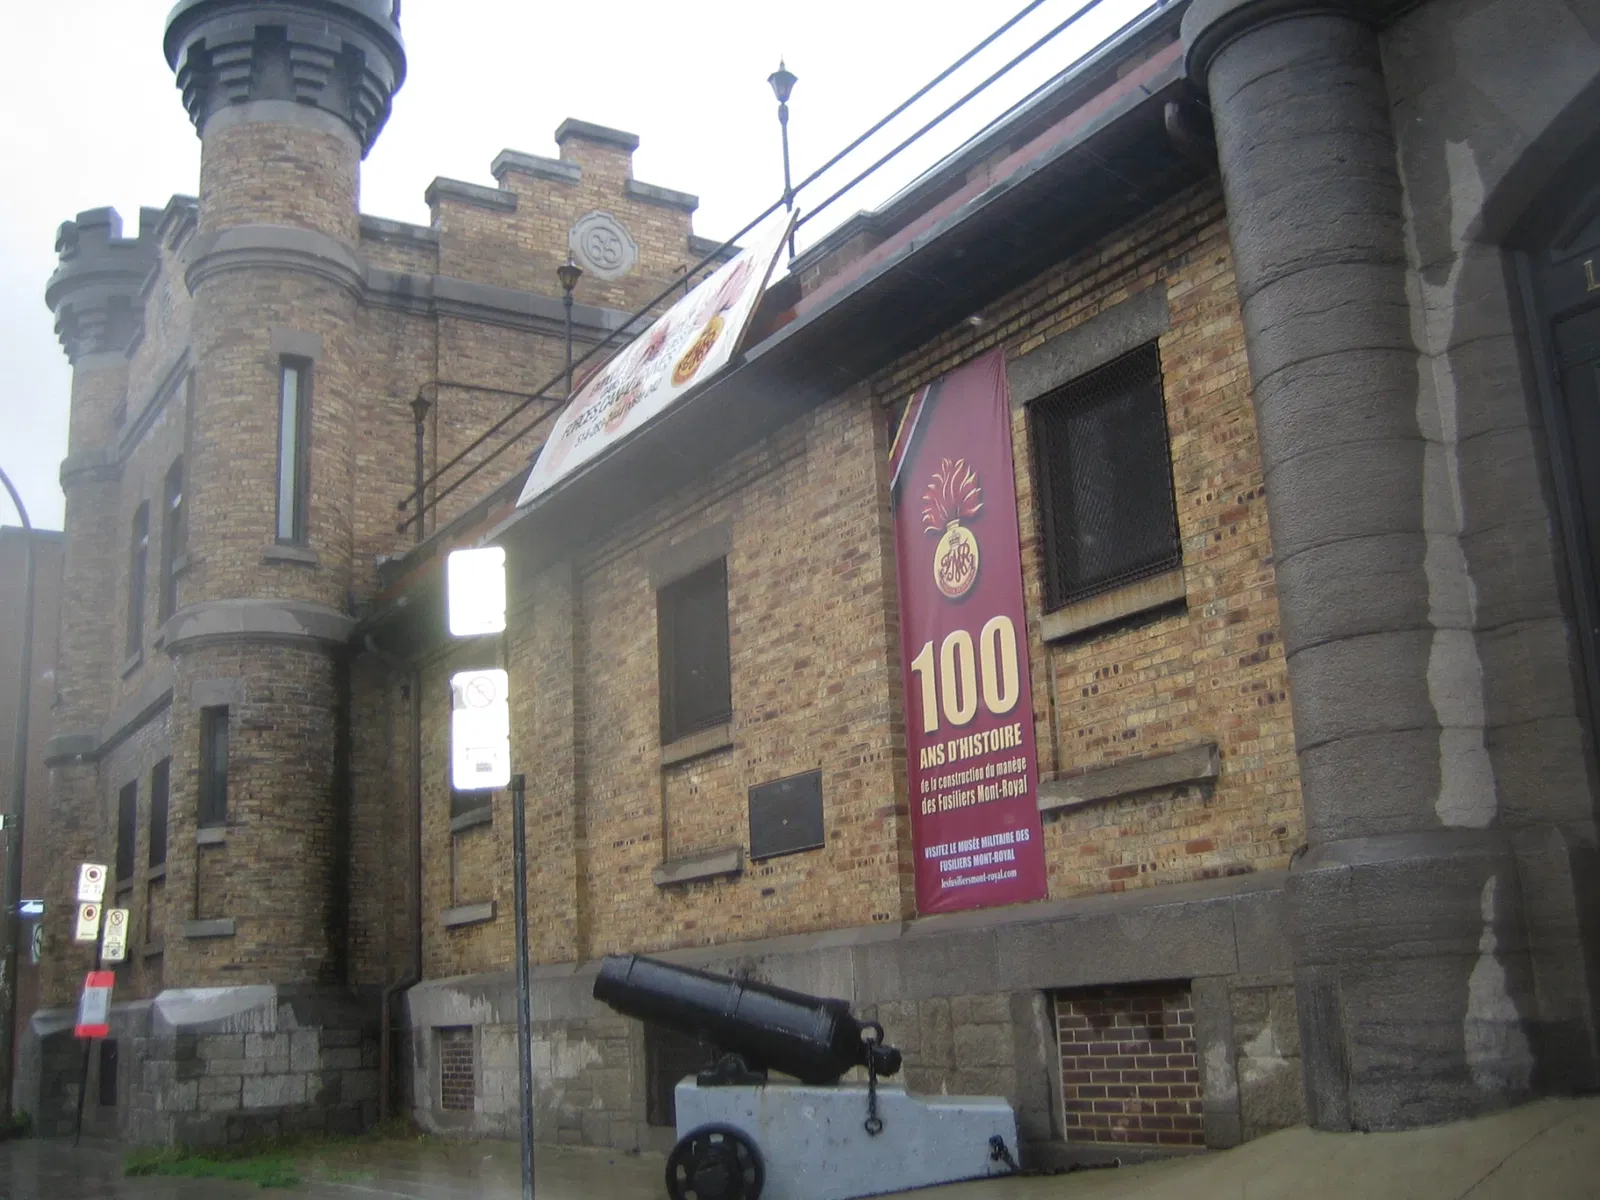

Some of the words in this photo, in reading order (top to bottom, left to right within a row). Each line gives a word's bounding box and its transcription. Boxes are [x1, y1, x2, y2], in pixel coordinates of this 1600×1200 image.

[910, 615, 1020, 734] 100
[920, 743, 945, 769] ANS
[947, 722, 1022, 763] D'HISTOIRE
[920, 778, 930, 794] de
[930, 776, 937, 791] la
[938, 765, 984, 788] construction
[985, 763, 995, 778] du
[996, 756, 1027, 774] manège
[921, 797, 936, 815] des
[938, 787, 976, 812] Fusiliers
[977, 774, 1028, 804] Mont-Royal
[924, 843, 949, 859] VISITEZ
[949, 842, 957, 855] LE
[957, 836, 980, 853] MUSÉE
[981, 831, 1015, 849] MILITAIRE
[1015, 828, 1030, 842] DES
[939, 856, 972, 873] FUSILIERS
[973, 848, 1016, 867] MONT-ROYAL
